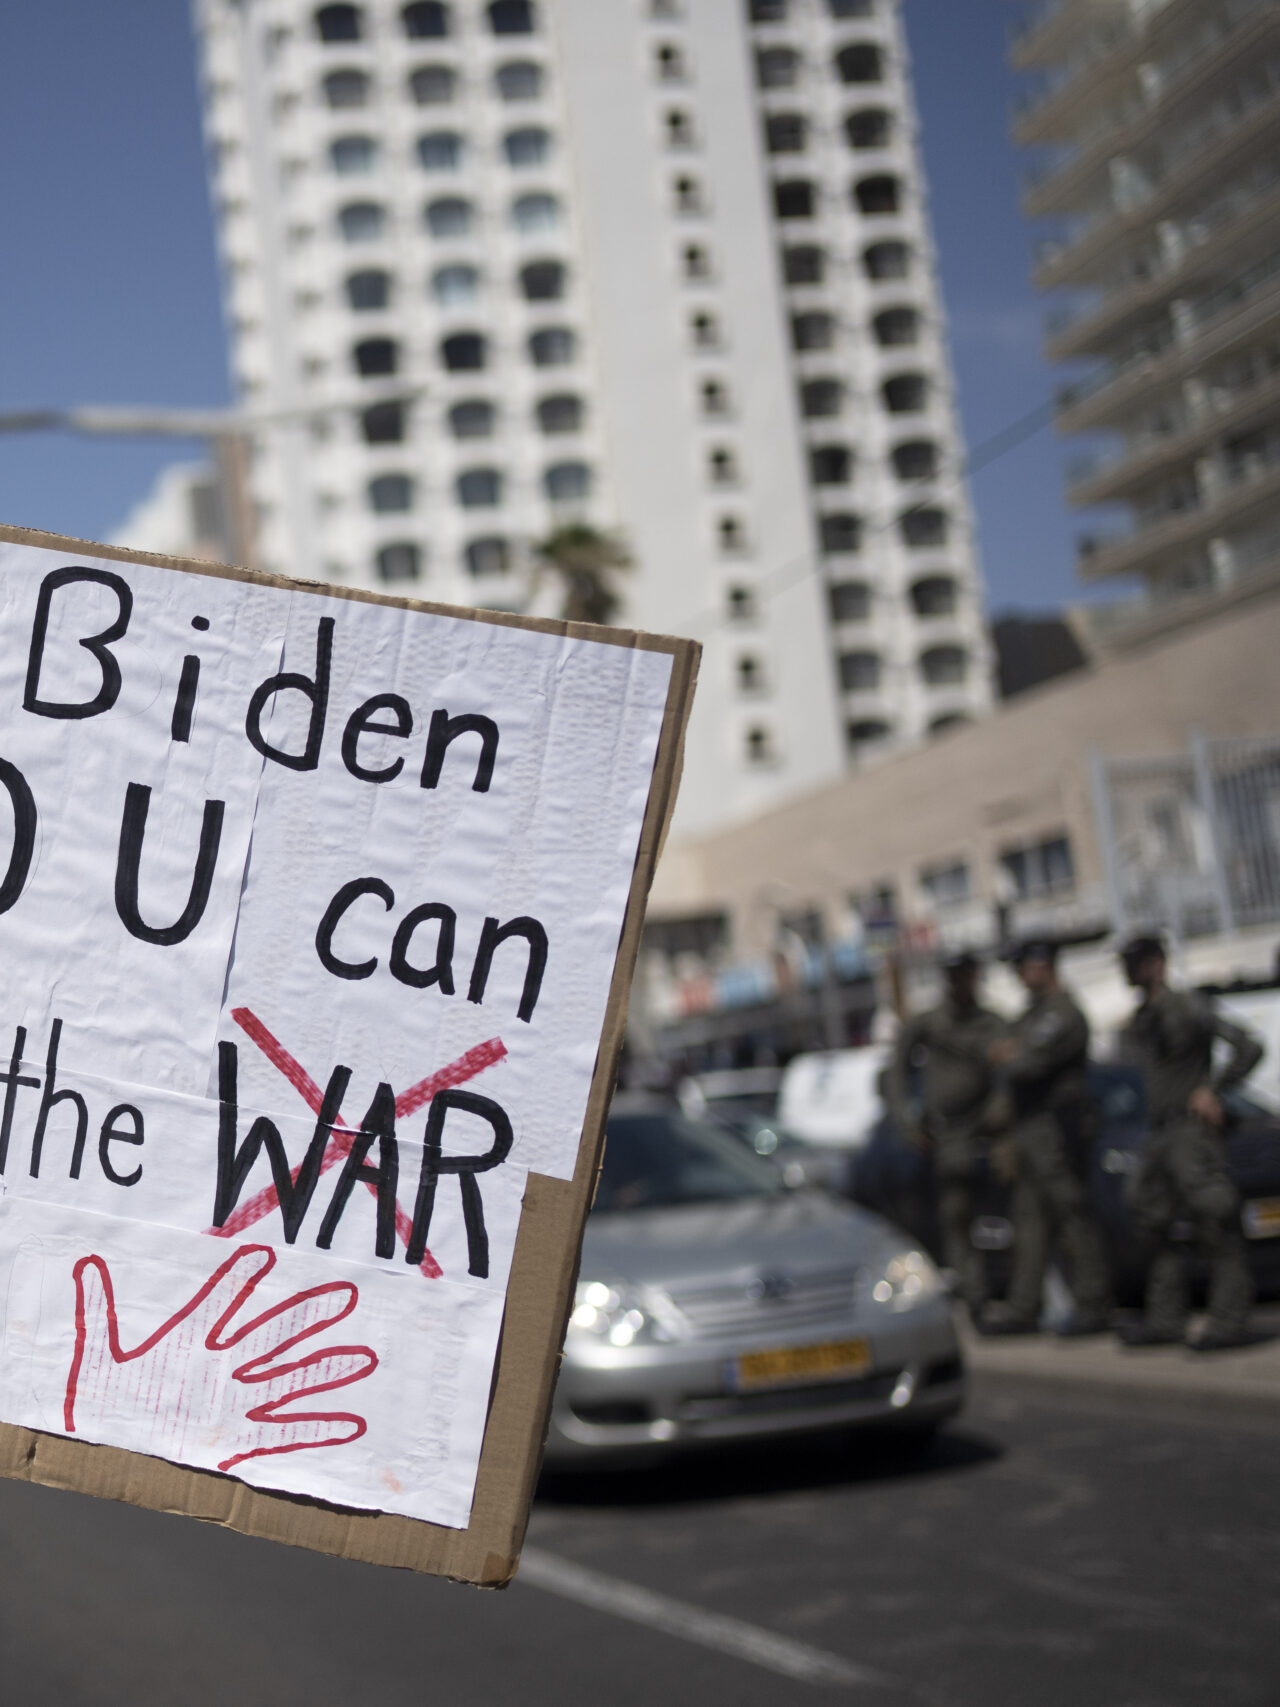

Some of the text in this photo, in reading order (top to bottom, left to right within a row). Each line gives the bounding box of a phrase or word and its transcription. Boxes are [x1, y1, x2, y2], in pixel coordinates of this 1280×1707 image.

[23, 566, 500, 793] Biden
[315, 876, 549, 1023] can
[213, 1040, 514, 1279] WAR
